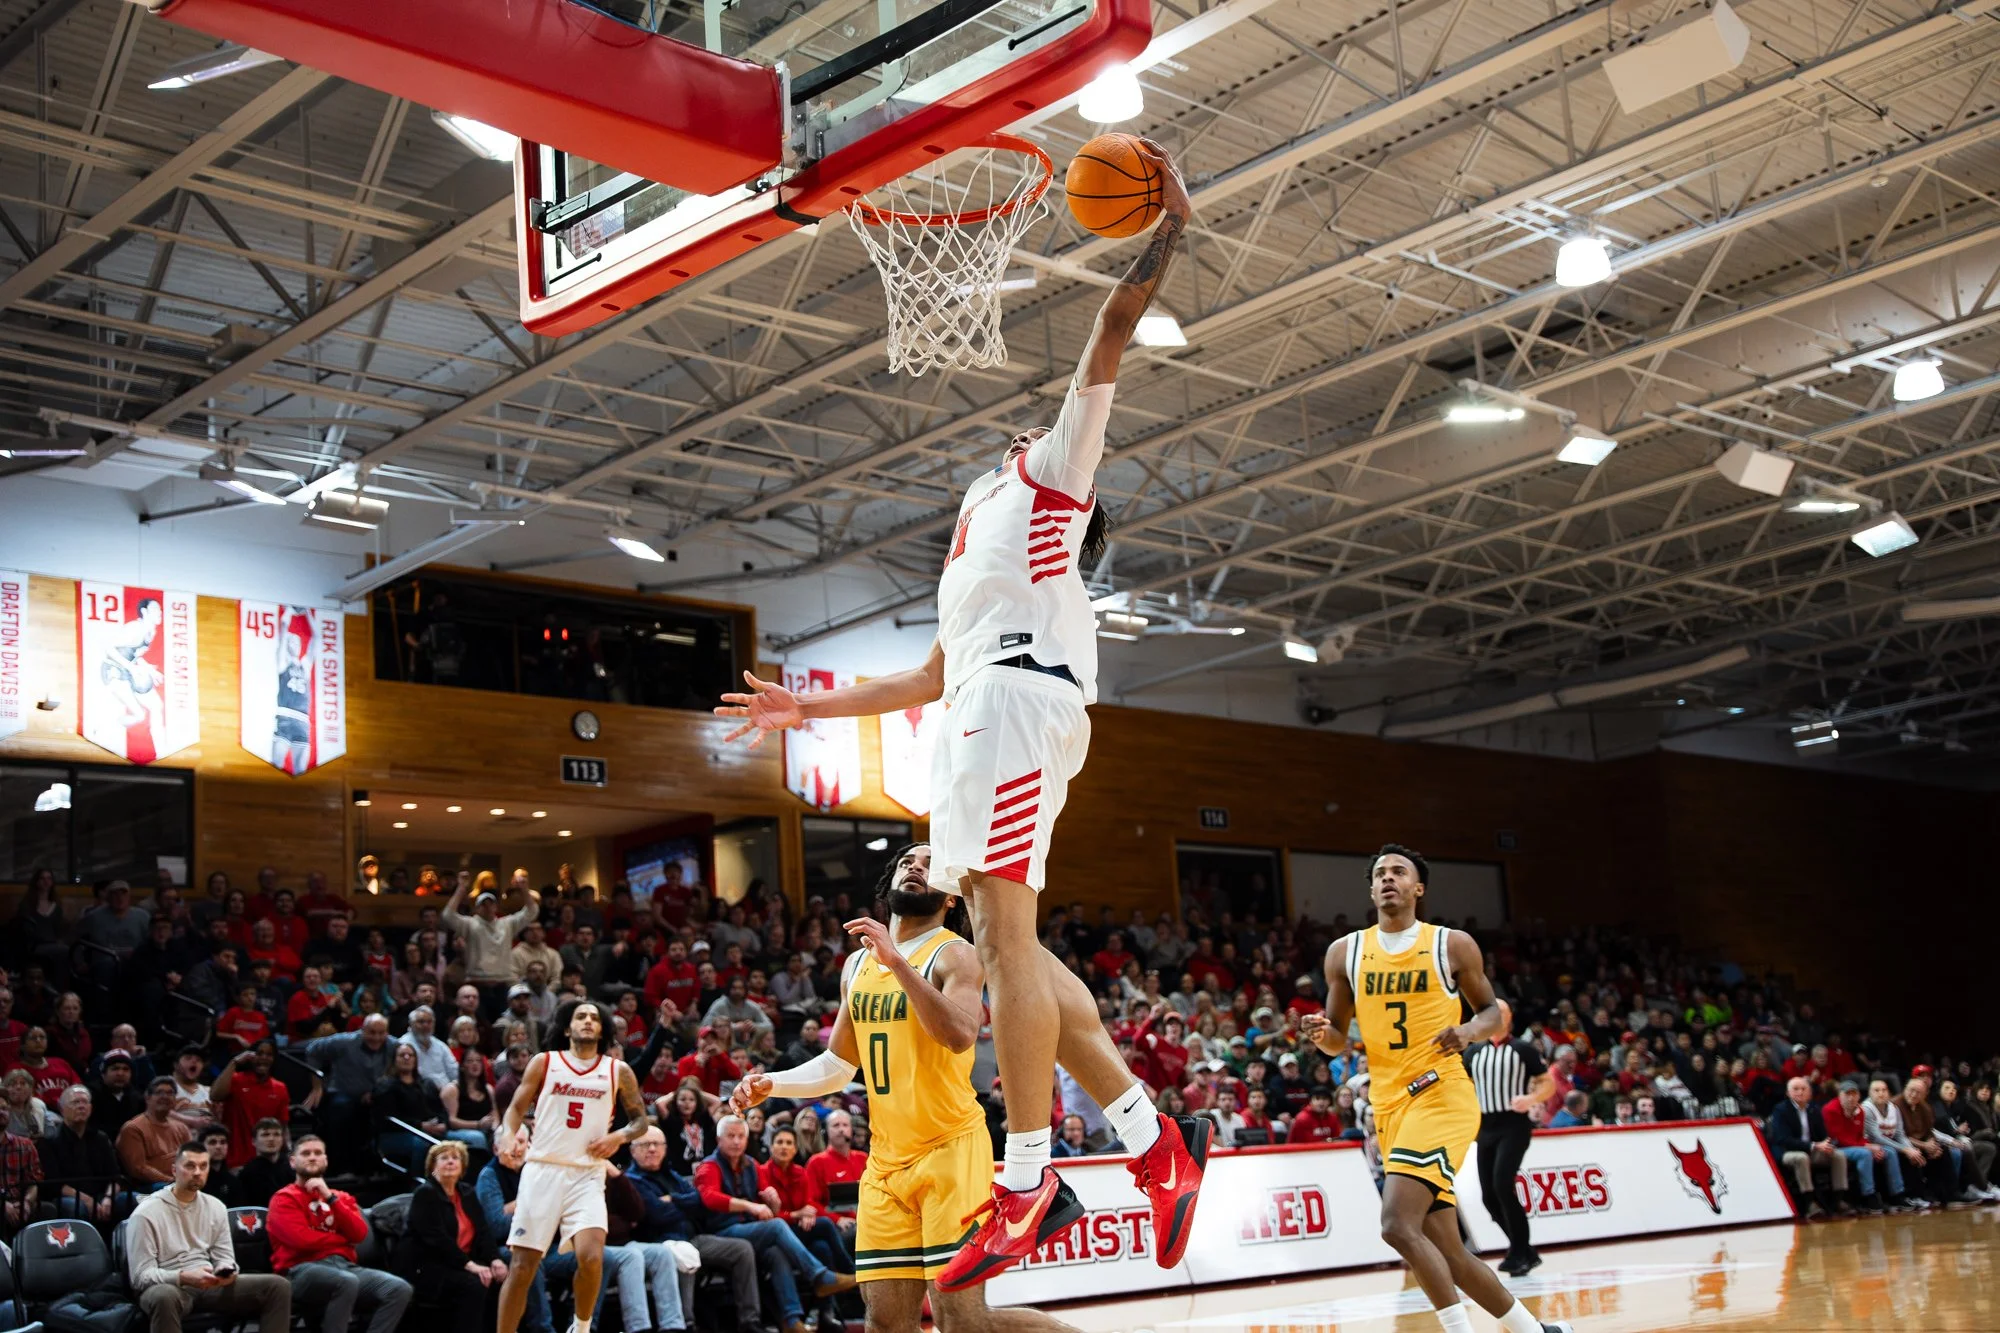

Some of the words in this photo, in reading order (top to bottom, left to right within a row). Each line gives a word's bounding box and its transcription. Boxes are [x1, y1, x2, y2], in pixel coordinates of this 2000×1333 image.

[1, 582, 19, 648] DRAFTON
[86, 592, 119, 623] 12
[172, 602, 189, 650] STEVE
[246, 610, 274, 639] 45
[322, 619, 338, 653] RIK
[1, 652, 19, 695] DAVIS
[174, 655, 189, 708] SMITH
[322, 658, 339, 721] SMITS
[569, 760, 601, 781] 113
[1362, 969, 1429, 996] SIENA
[852, 989, 908, 1023] SIENA
[1384, 1001, 1409, 1051] 3
[869, 1032, 891, 1095] 0
[566, 1101, 584, 1129] 5
[1514, 1167, 1609, 1214] OXES
